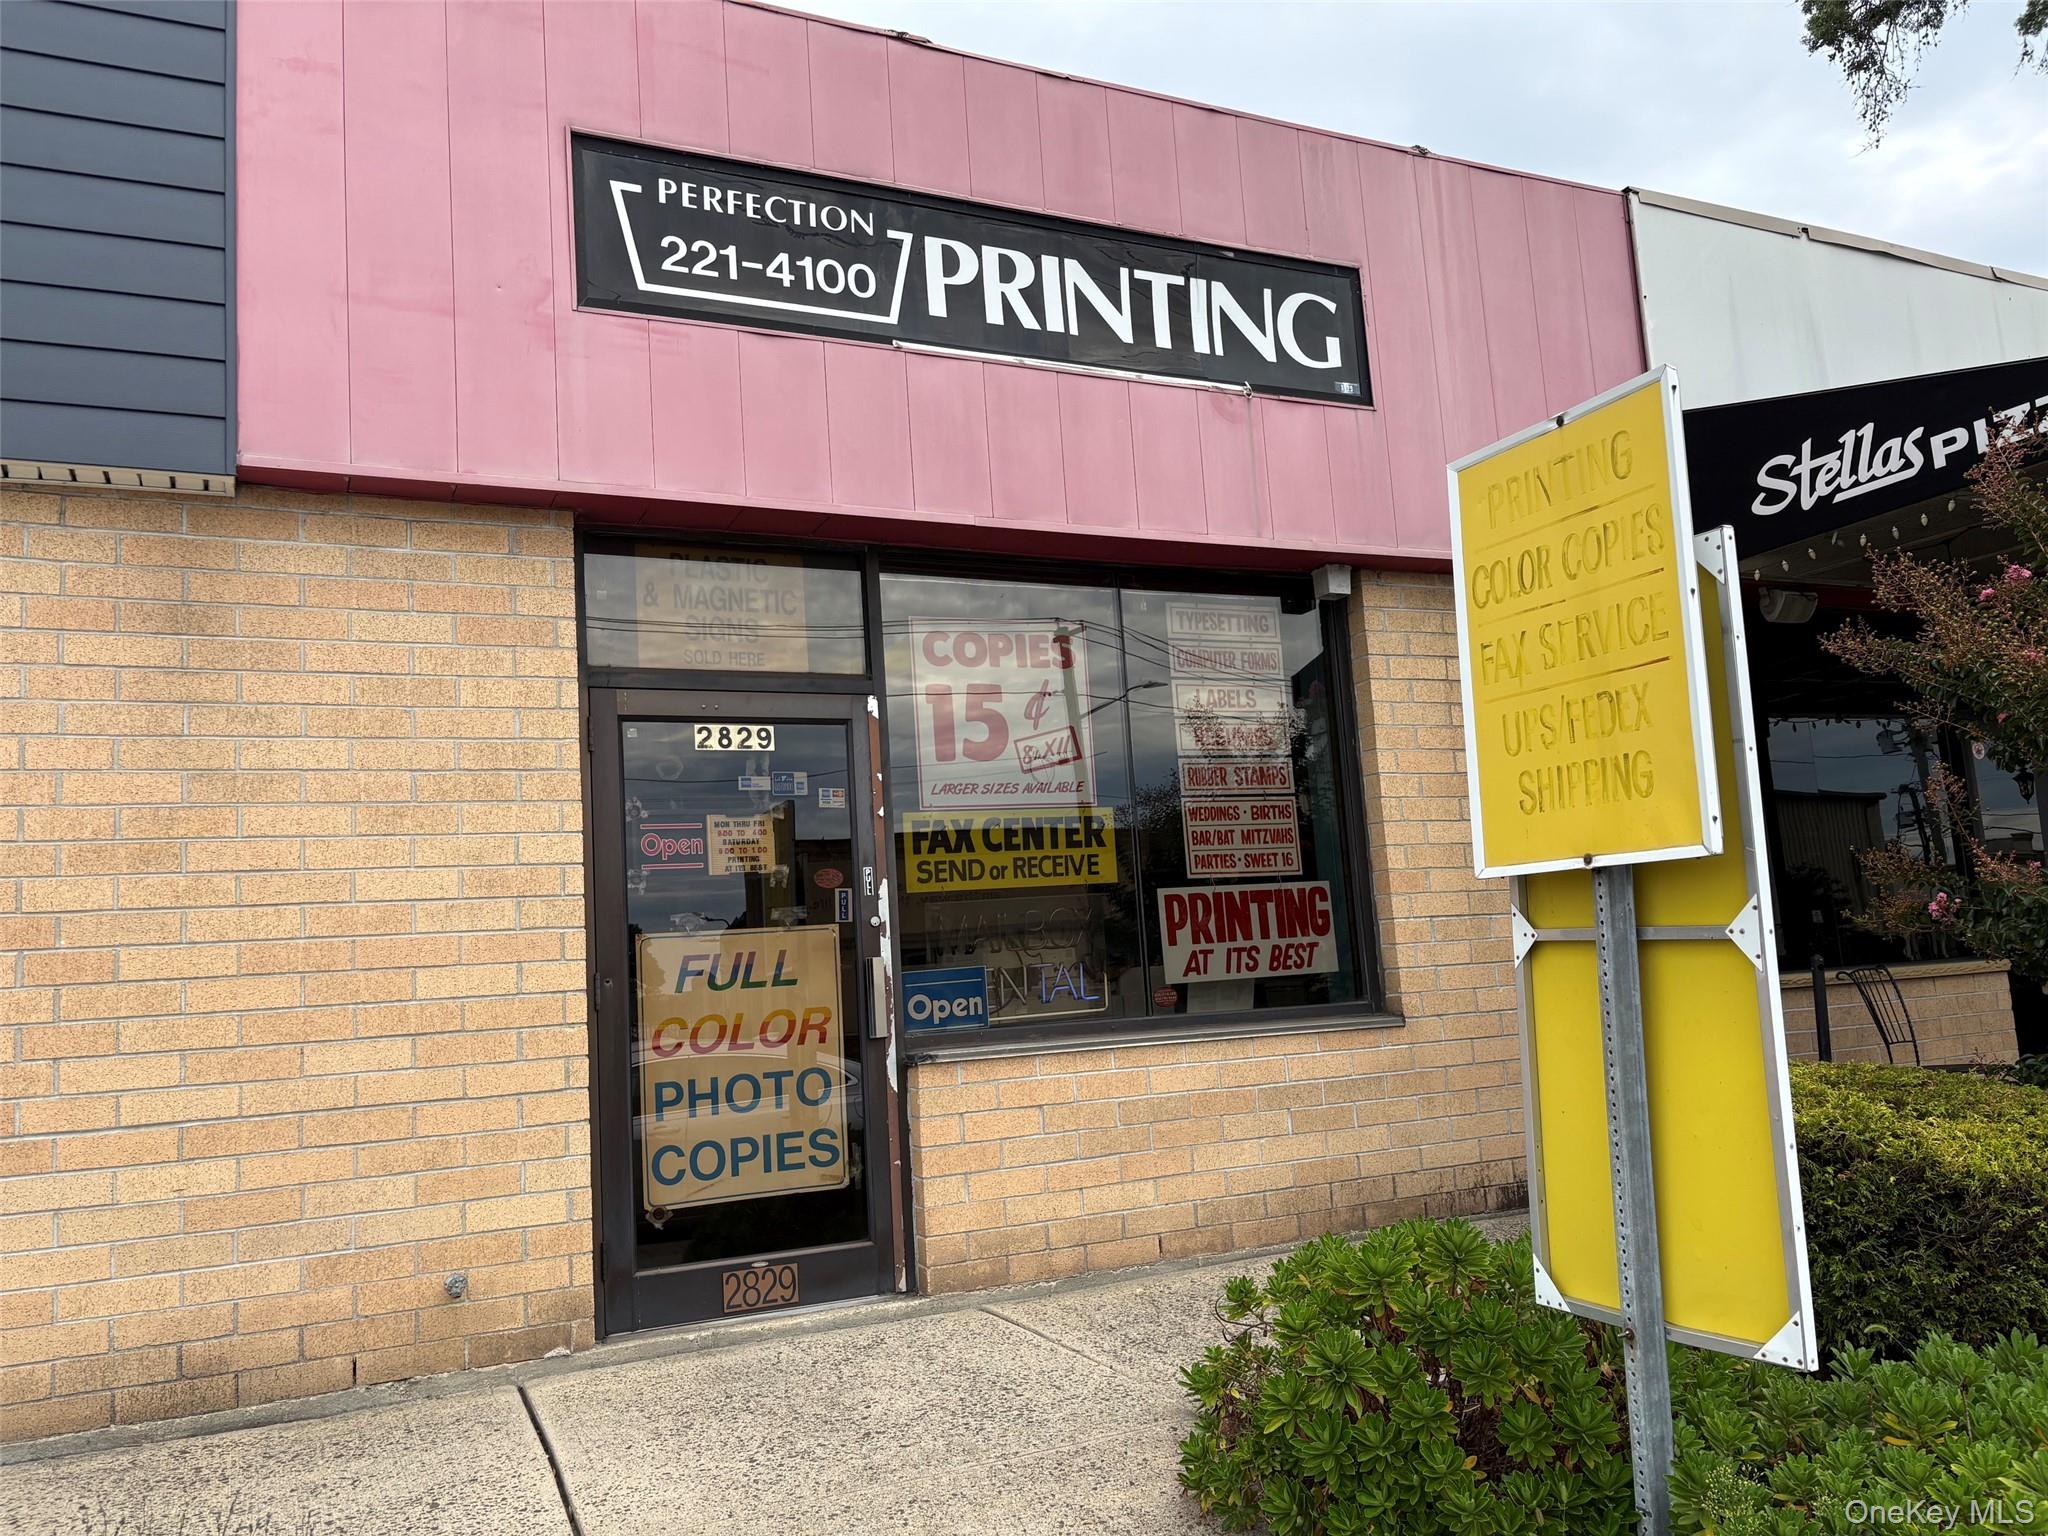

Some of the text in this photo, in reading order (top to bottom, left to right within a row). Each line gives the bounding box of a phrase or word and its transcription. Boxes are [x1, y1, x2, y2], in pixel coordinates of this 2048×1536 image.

[658, 177, 874, 237] PERFECTION
[660, 235, 877, 299] 221-4100
[923, 234, 1342, 369] PRINTING
[1487, 430, 1632, 529] PRINTING
[1750, 422, 1925, 516] Stellas
[669, 552, 769, 584] PLASTIC
[1472, 502, 1665, 610] COLOR COPIES
[643, 580, 798, 616] & MAGNETIC
[685, 615, 759, 644] SIGNS
[1175, 610, 1270, 634] TYPESETTING
[1480, 591, 1670, 686] FAX SERVICE
[683, 650, 766, 667] SOLD HERE
[922, 630, 1075, 669] COPIES
[1176, 649, 1278, 672] COMPUTER FORMS
[1195, 688, 1257, 709] LABELS
[697, 726, 772, 749] 2829
[925, 683, 1009, 762] 15
[1502, 681, 1652, 758] UPS/FEDEX
[931, 781, 1085, 796] LARGER SIZES AVAILABLE
[1187, 765, 1287, 787] RUBBER STAMPS
[1518, 750, 1655, 816] SHIPPING
[733, 820, 751, 828] THRU
[1188, 804, 1292, 822] WEDDINGS BIRTHS
[640, 833, 704, 861] Open
[722, 837, 760, 846] SATURDAY
[911, 815, 1107, 855] FAX CENTER
[1191, 827, 1294, 847] BAR/BAT MITZVAHS
[727, 855, 760, 864] PRINTING
[916, 853, 1100, 884] SEND or RECEIVE
[1194, 852, 1294, 870] PARTIES SWEET 16
[1163, 886, 1331, 947] PRINTING
[674, 949, 799, 994] FULL
[1182, 942, 1320, 978] AT ITS BEST
[907, 993, 983, 1024] Open
[651, 1006, 833, 1059] COLOR
[654, 1067, 832, 1122] PHOTO
[651, 1127, 841, 1186] COPIES
[724, 1265, 798, 1311] 2829
